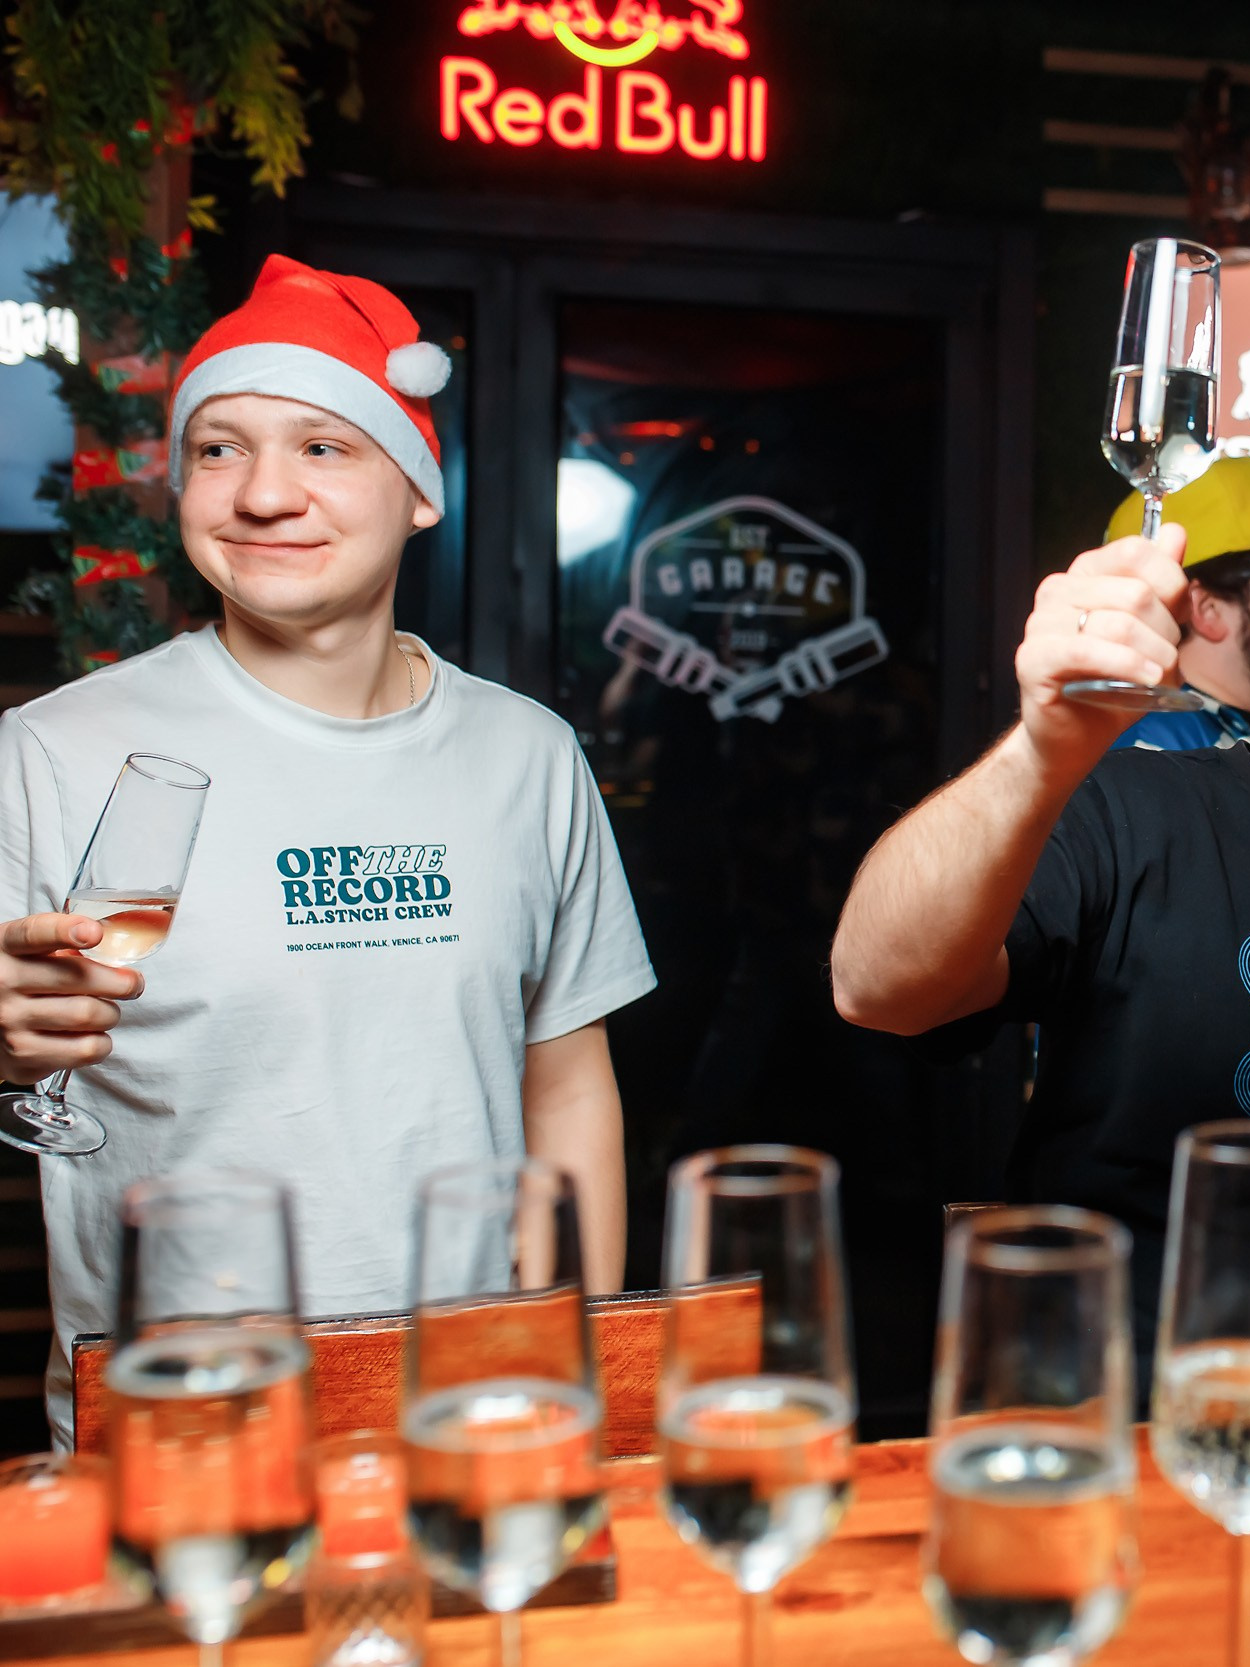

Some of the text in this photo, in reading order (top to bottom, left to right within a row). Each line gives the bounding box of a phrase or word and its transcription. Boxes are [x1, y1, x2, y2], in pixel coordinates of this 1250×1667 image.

[440, 55, 768, 163] Red Bull
[657, 556, 841, 604] GARAGE
[280, 873, 451, 908] RECORD
[286, 903, 453, 926] L.A.STNCH CREW
[286, 943, 304, 952] 1900
[305, 941, 335, 951] OCEAN
[335, 939, 362, 950] FRONT
[425, 935, 438, 945] CA
